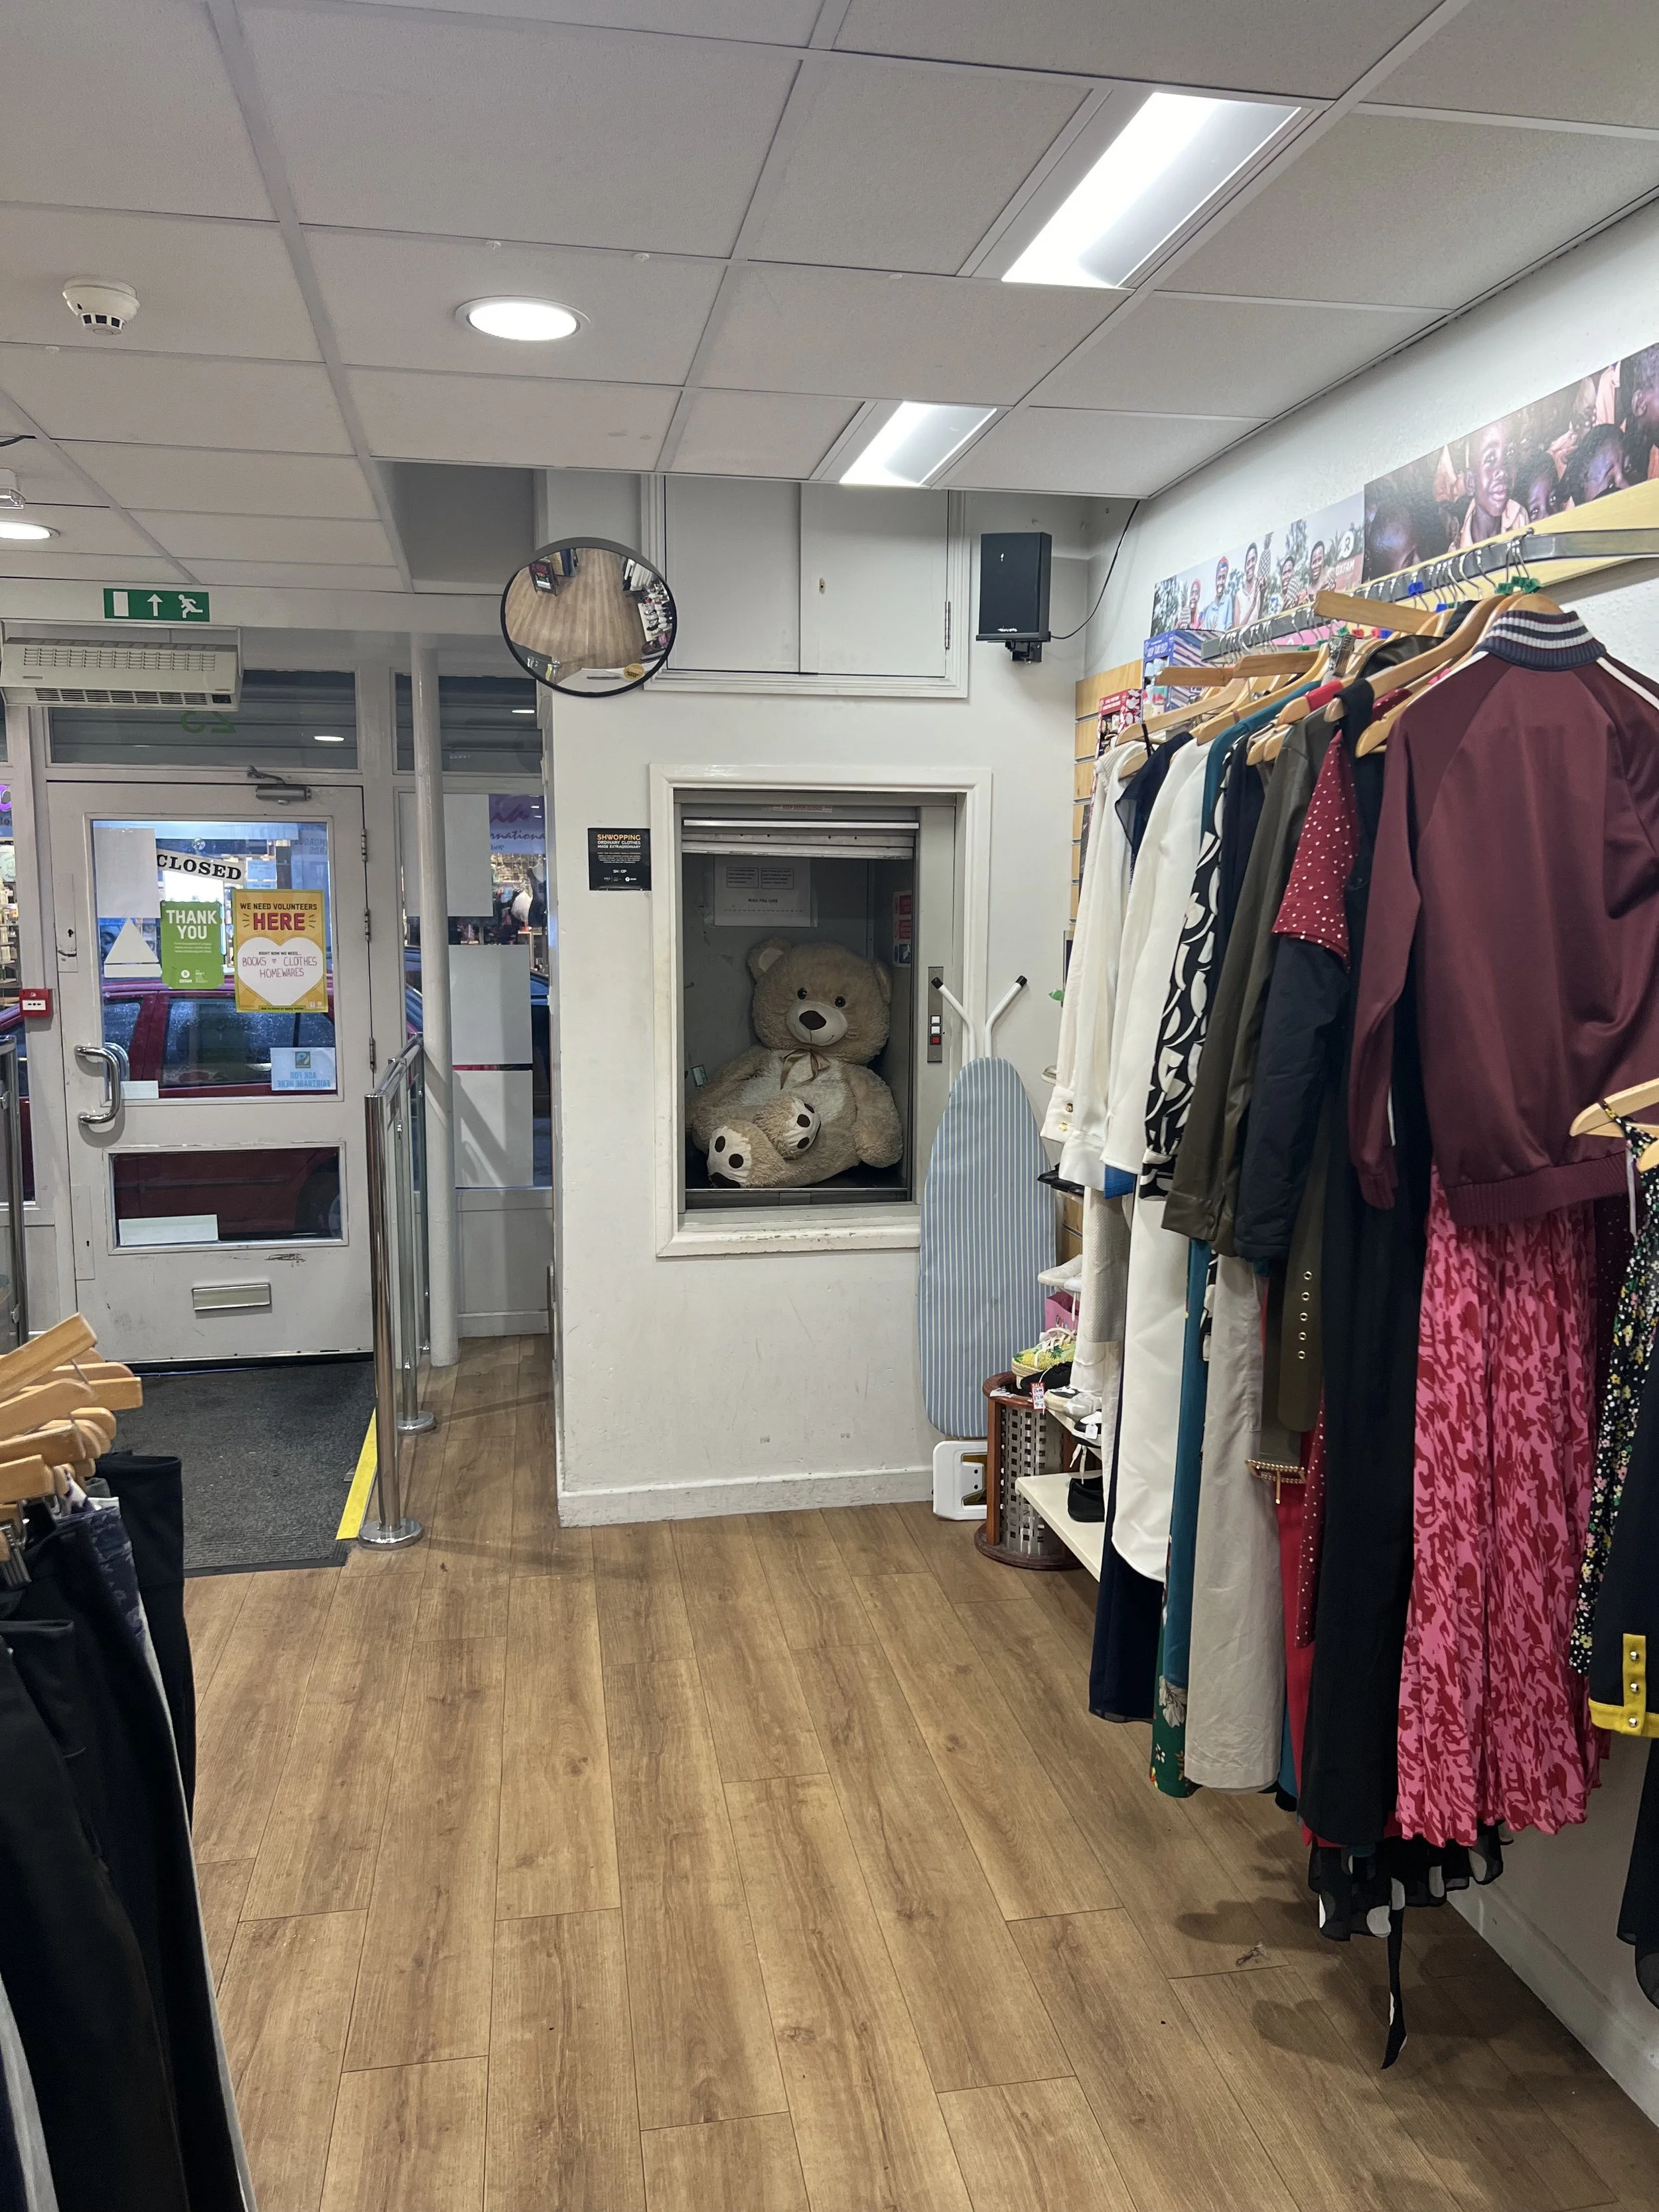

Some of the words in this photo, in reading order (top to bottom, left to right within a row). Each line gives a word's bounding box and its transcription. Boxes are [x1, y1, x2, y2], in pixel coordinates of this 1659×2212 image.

[157, 854, 242, 880] CLOSED
[166, 910, 218, 924] THANK
[253, 913, 306, 930] HERE
[177, 925, 207, 940] YOU
[242, 957, 267, 967] BOOKS
[283, 956, 318, 966] CLOTHES
[259, 968, 305, 978] HOMEWARES
